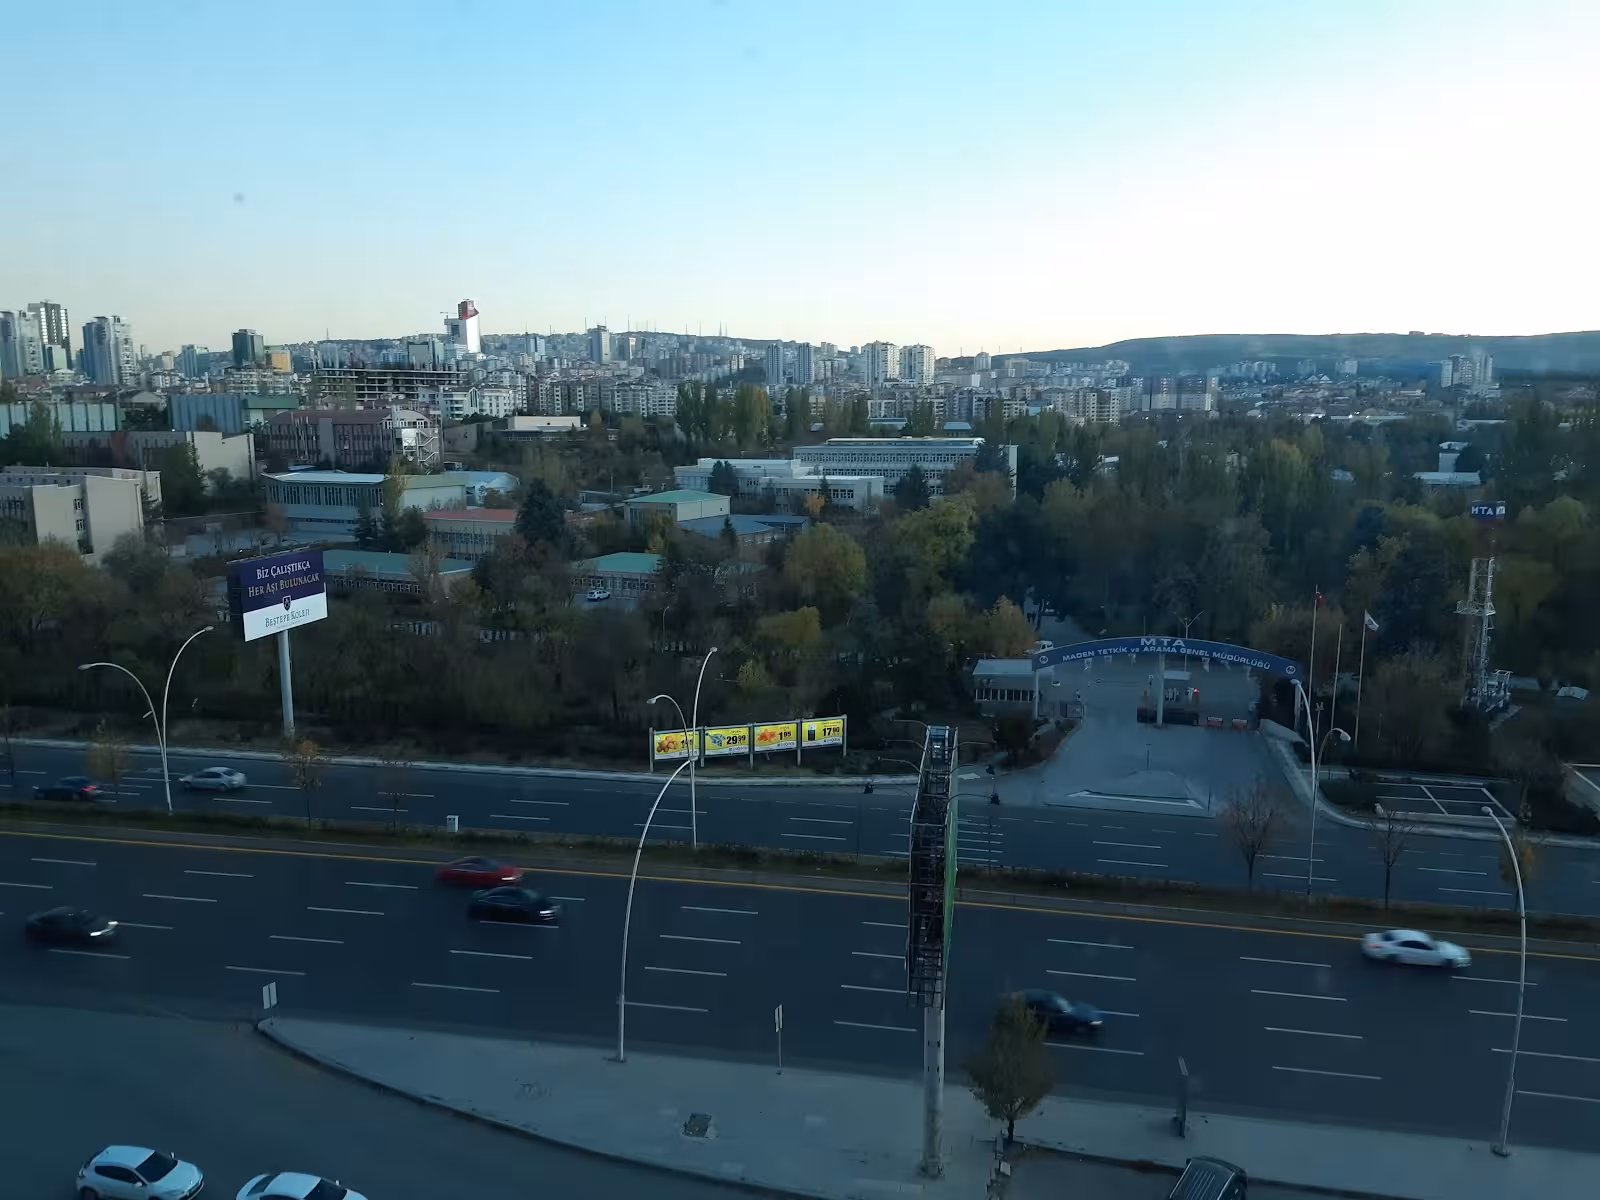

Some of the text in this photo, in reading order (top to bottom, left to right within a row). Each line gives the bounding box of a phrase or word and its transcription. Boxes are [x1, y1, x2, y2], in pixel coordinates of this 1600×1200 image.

[256, 560, 311, 579] BİZ ÇALIŞTIKÇA
[248, 573, 320, 597] HER AŞI BULUNACAK
[1140, 638, 1186, 647] MTA
[1062, 650, 1095, 662] MADEN
[1097, 646, 1128, 655] TETKİK
[1179, 647, 1210, 656] GENEL
